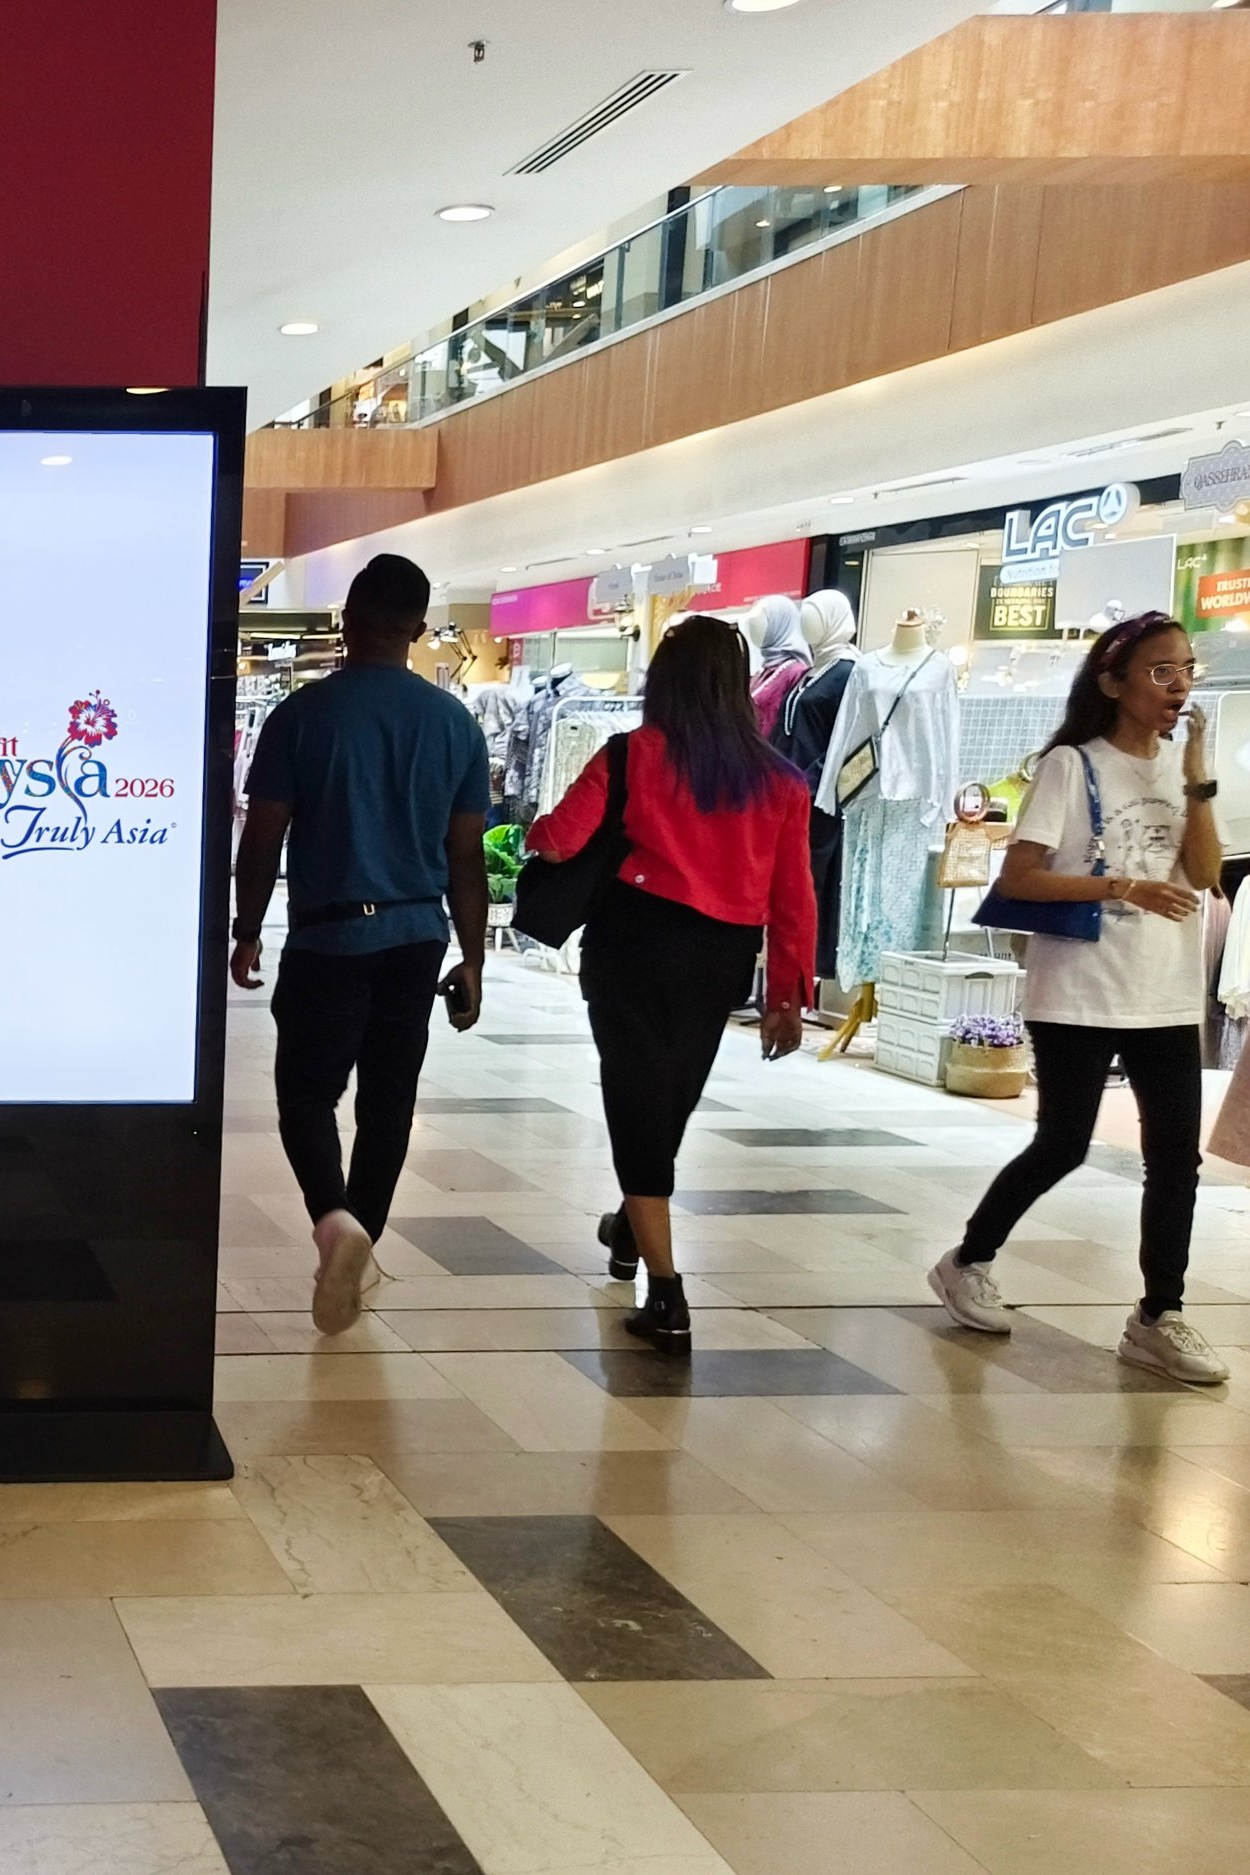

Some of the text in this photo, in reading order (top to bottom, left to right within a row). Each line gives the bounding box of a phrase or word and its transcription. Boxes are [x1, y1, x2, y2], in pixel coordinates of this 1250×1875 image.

[1002, 495, 1100, 563] LAC
[1177, 556, 1201, 570] LAC
[990, 587, 1054, 598] BOUNDARIES
[994, 605, 1046, 627] BEST
[114, 778, 175, 798] 2026
[1, 805, 169, 851] Truly Asia
